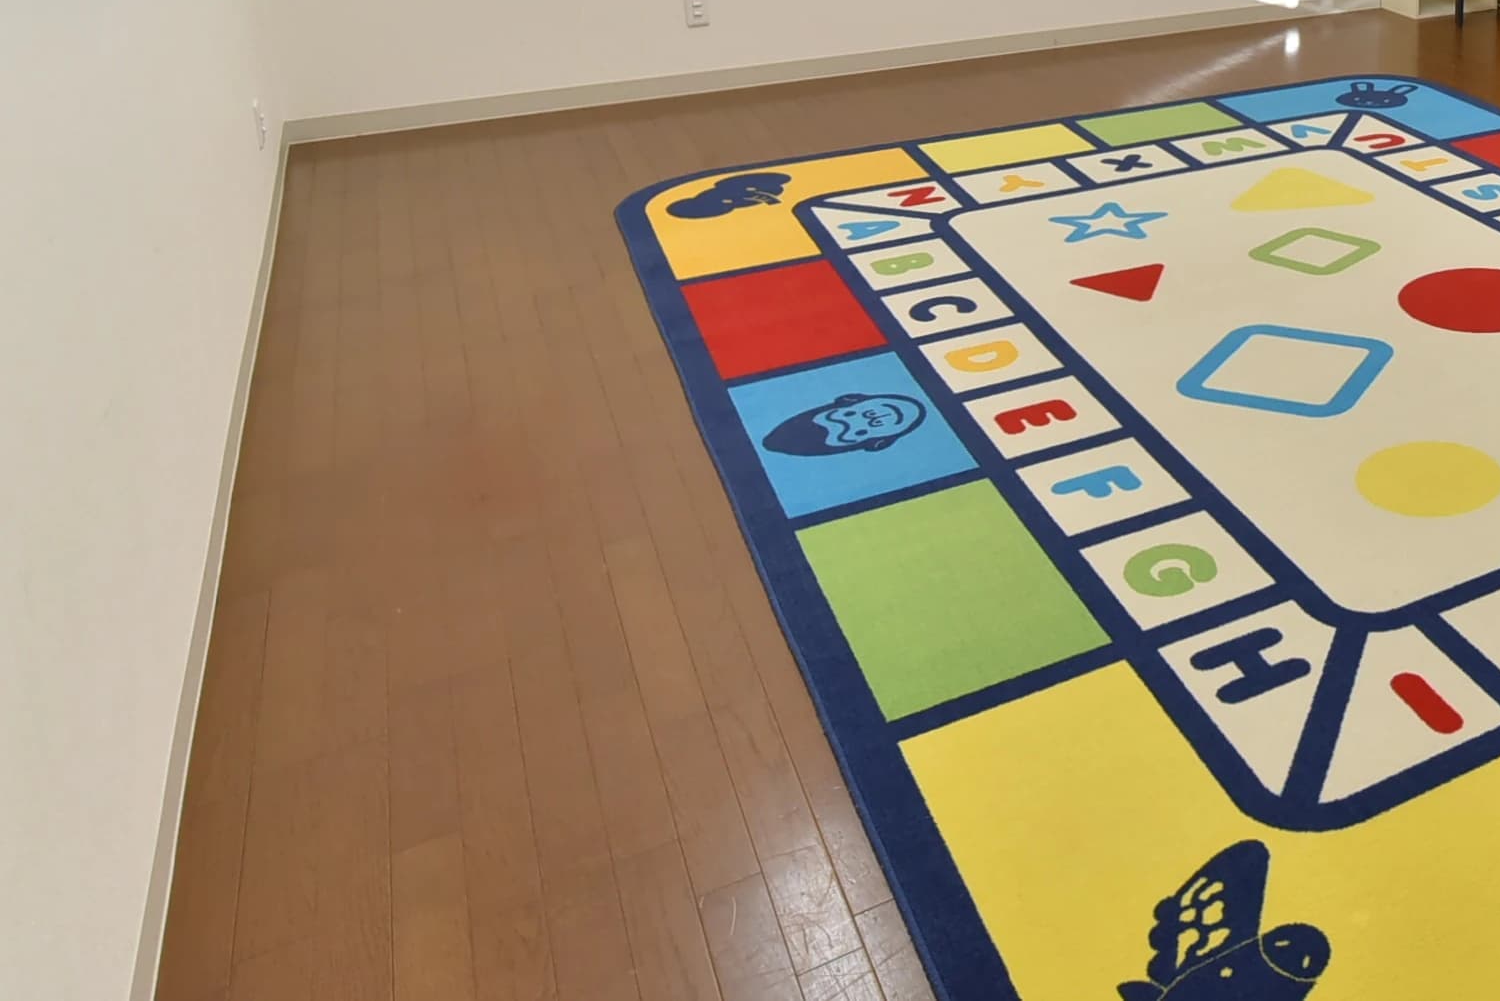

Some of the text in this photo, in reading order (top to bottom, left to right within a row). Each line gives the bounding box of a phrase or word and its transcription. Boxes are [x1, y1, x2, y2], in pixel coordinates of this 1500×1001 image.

[1292, 126, 1330, 137] V
[1354, 133, 1407, 149] U
[1101, 154, 1152, 172] X
[1399, 157, 1450, 173] T
[999, 174, 1047, 193] Y
[839, 222, 1311, 704] A B C D E F G H
[1390, 671, 1466, 735] I
